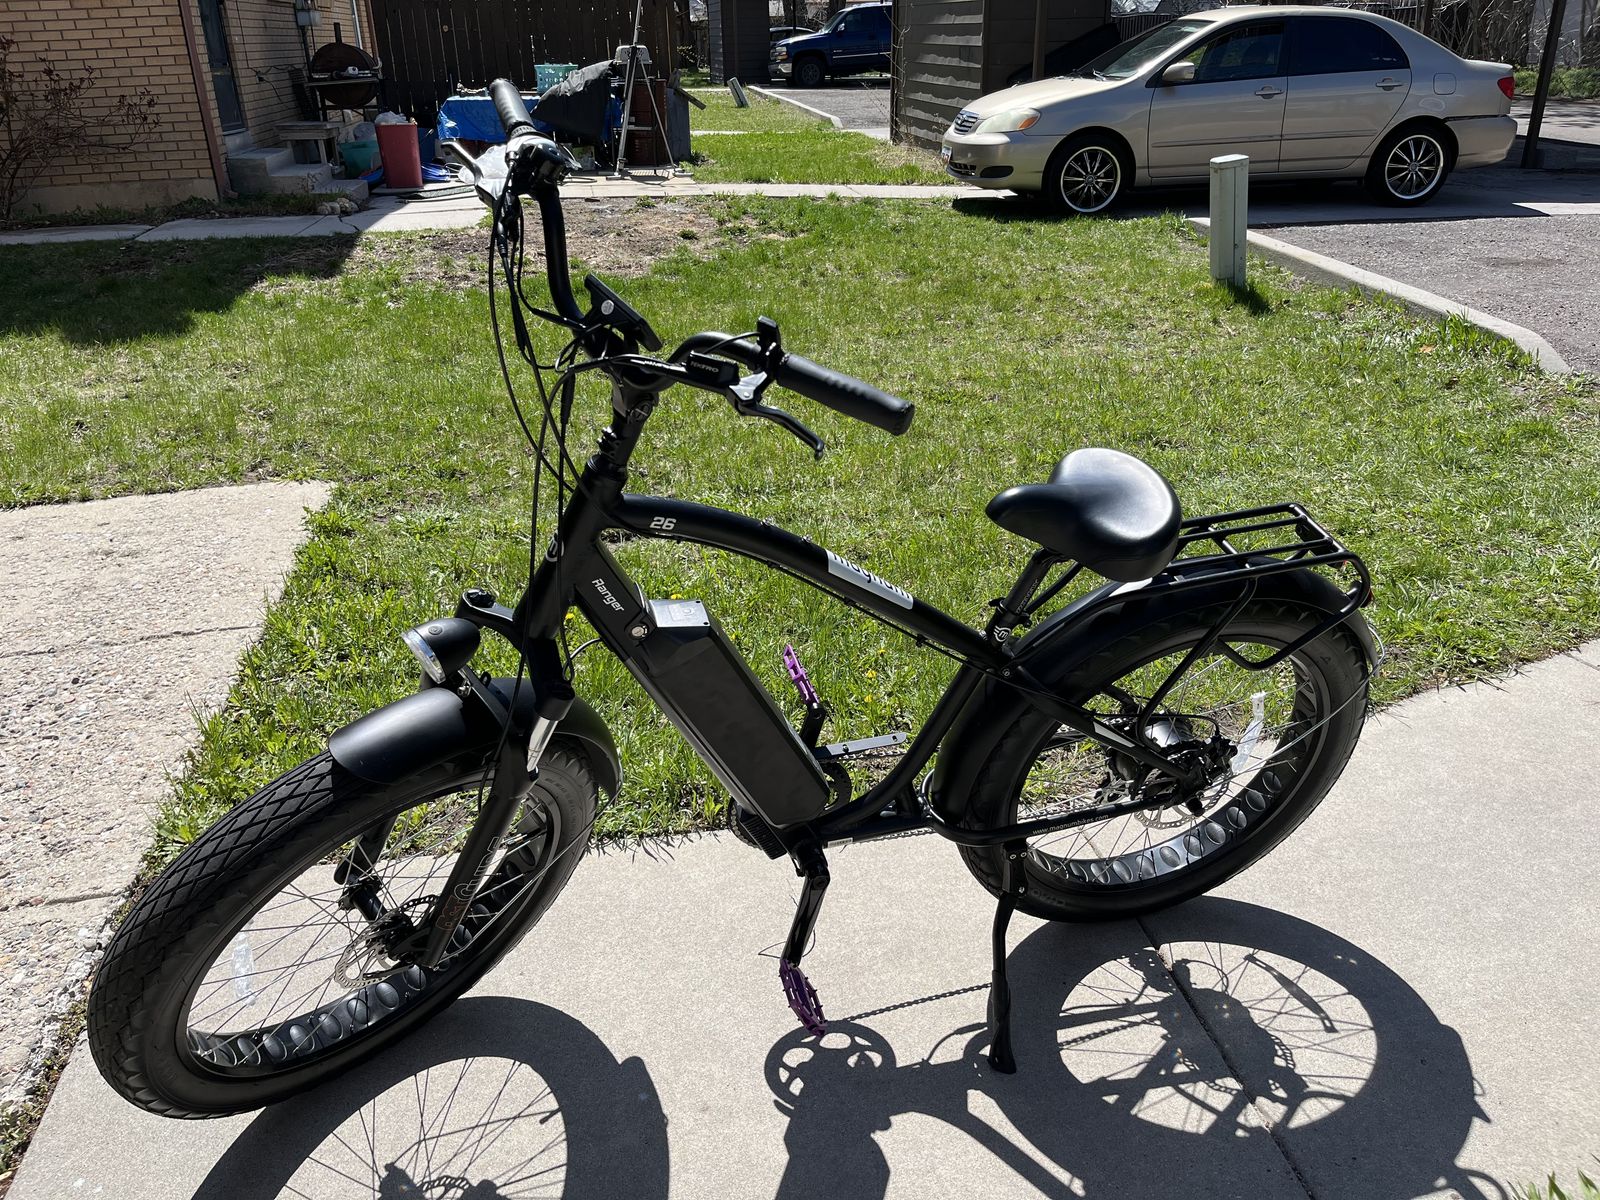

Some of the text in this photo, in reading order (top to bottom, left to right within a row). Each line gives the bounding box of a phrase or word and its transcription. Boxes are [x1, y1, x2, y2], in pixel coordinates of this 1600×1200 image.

[649, 516, 677, 531] 26
[591, 577, 625, 612] Ranger
[1032, 814, 1109, 835] www.magnumbikes.com
